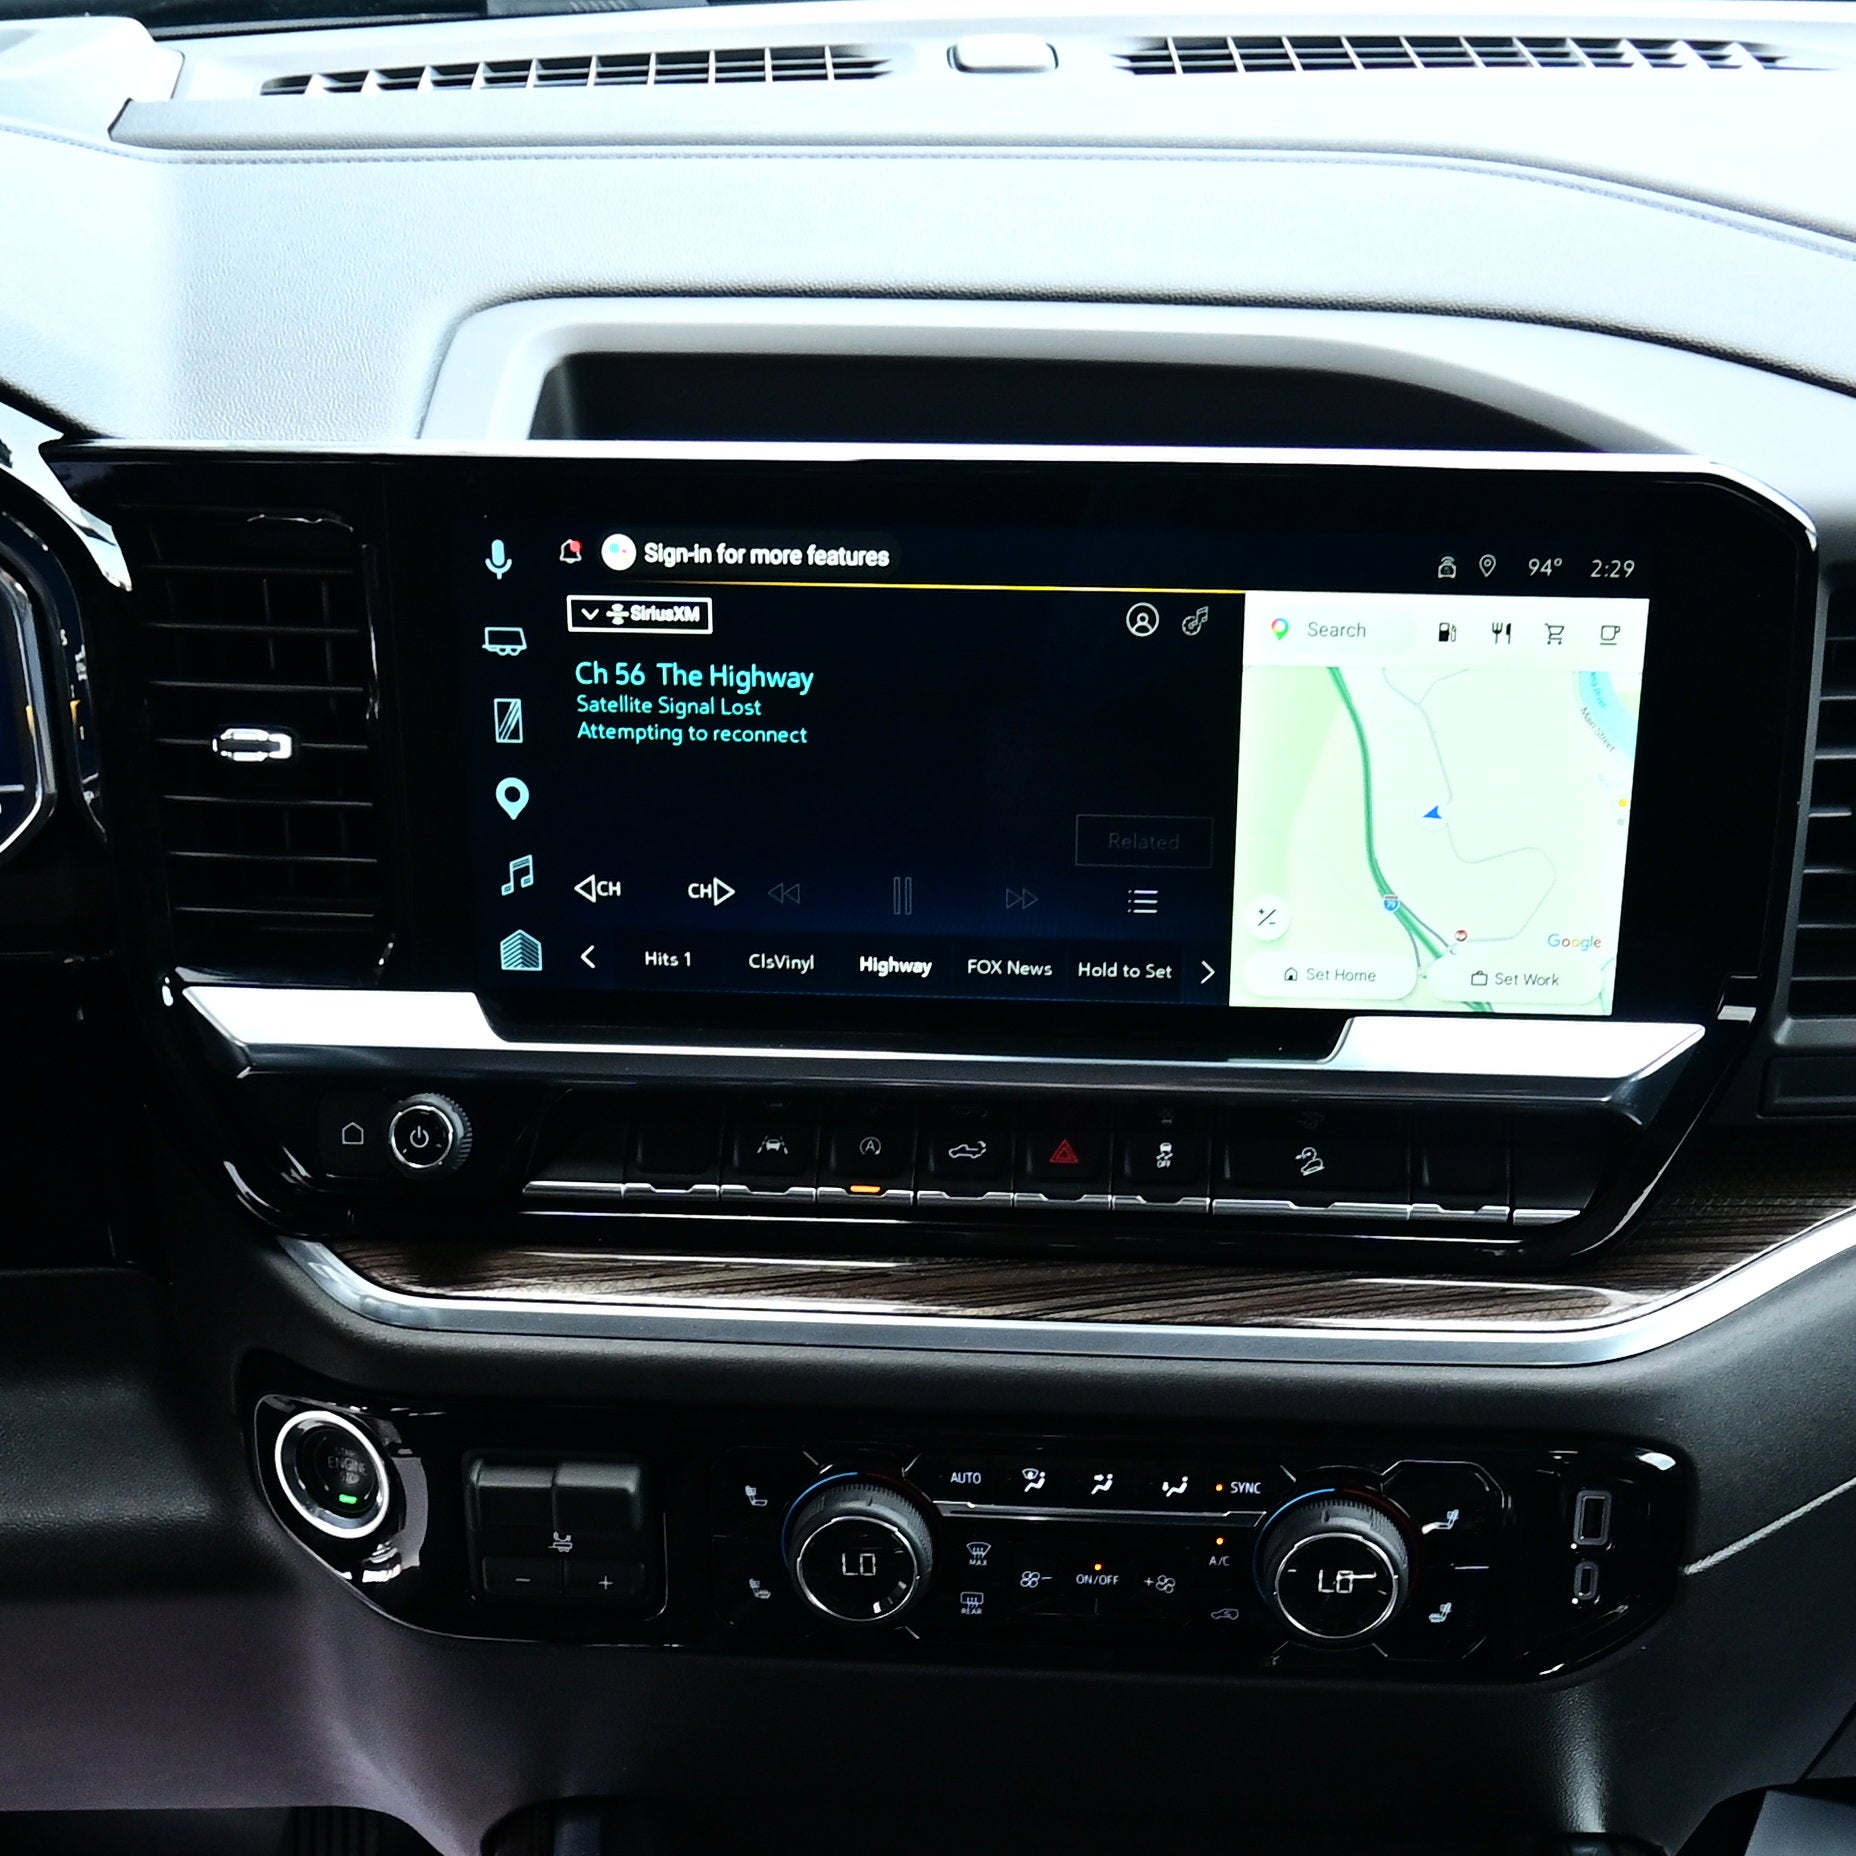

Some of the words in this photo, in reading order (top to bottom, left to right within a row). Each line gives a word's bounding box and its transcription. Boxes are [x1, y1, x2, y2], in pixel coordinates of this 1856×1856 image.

[643, 541, 713, 568] Sign-in
[715, 542, 747, 565] for
[749, 547, 803, 566] more
[806, 543, 890, 567] features
[1528, 557, 1563, 577] 94°
[1590, 559, 1635, 578] 2:29
[629, 604, 701, 623] SiriusXM
[1307, 621, 1367, 638] Search
[575, 660, 609, 685] Ch
[615, 661, 646, 686] 56
[655, 661, 704, 687] The
[709, 663, 815, 696] Highway
[576, 693, 653, 714] Satellite
[657, 695, 715, 720] Signal
[720, 697, 762, 716] Lost
[577, 720, 683, 747] Attempting
[687, 725, 709, 742] to
[713, 727, 808, 744] reconnect
[1106, 831, 1181, 853] Related
[596, 880, 622, 897] CH
[687, 882, 713, 899] CH
[1547, 932, 1602, 952] Google
[644, 950, 679, 967] Hits
[683, 951, 691, 967] 1
[748, 952, 815, 975] ClsVinyl
[859, 955, 933, 978] Highway
[967, 958, 1003, 975] FOX
[1007, 959, 1053, 976] News
[1078, 961, 1118, 978] Hold
[1122, 964, 1141, 978] to
[1145, 963, 1173, 979] Set
[1306, 967, 1330, 981] Set
[1334, 969, 1377, 983] Home
[1495, 971, 1519, 986] Set
[1523, 973, 1560, 987] Work
[950, 1471, 982, 1485] AUTO
[1230, 1481, 1262, 1495] SYNC
[1208, 1555, 1230, 1567] A/C
[1075, 1573, 1119, 1586] ON/OFF
